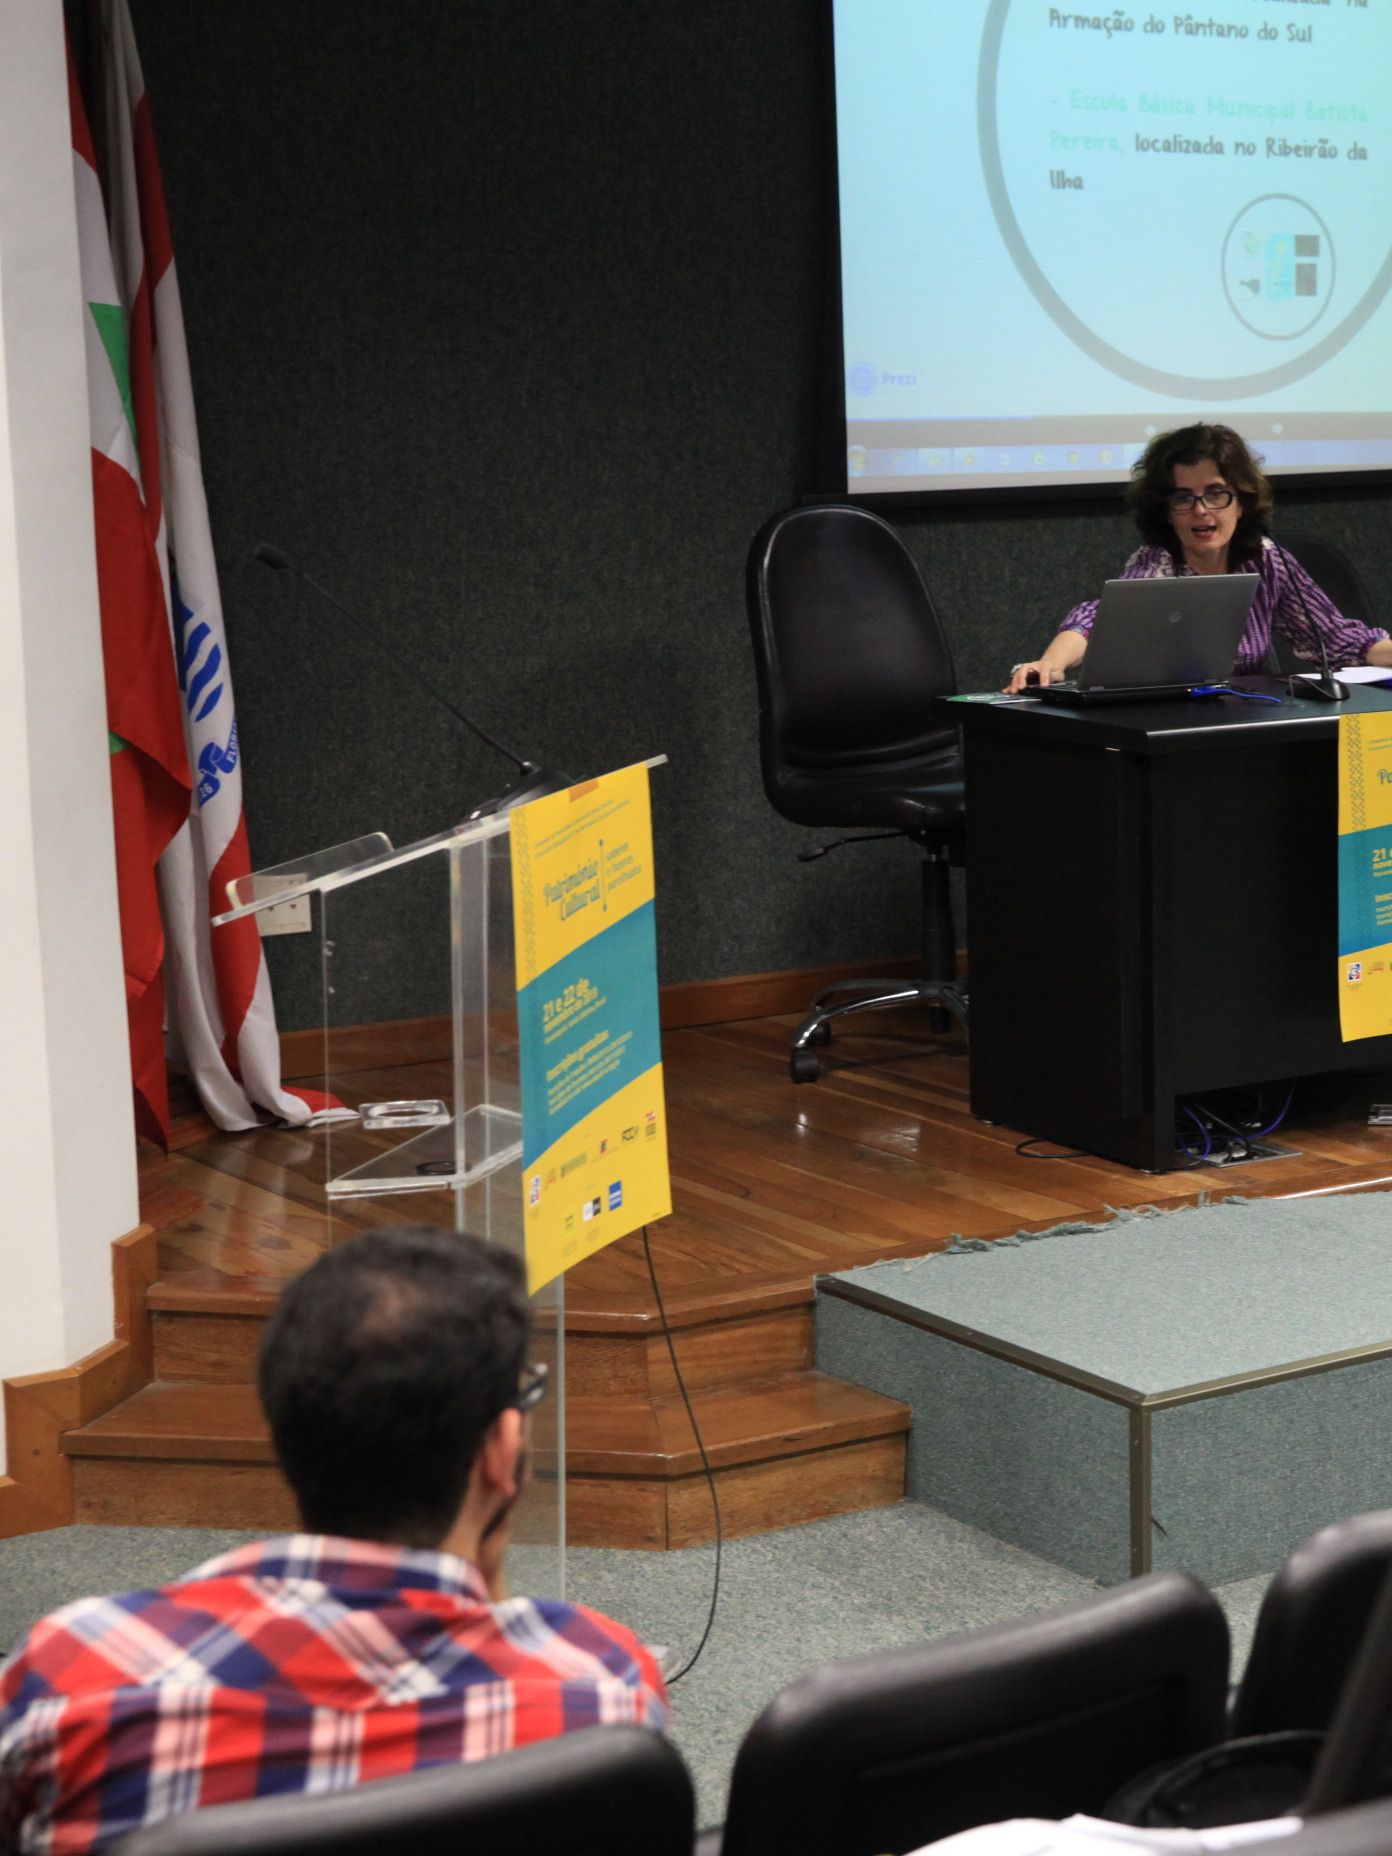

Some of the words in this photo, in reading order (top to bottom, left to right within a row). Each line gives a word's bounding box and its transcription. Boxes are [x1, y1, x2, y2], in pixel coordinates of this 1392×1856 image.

[1049, 8, 1134, 38] Armação
[1143, 14, 1165, 34] do
[1174, 15, 1249, 39] Pântano
[1257, 21, 1279, 41] do
[1287, 24, 1312, 43] Sul
[1069, 90, 1128, 112] Escola
[1138, 92, 1195, 115] Básica
[1207, 96, 1296, 124] Municipal
[1305, 101, 1369, 123] Batista
[1134, 133, 1225, 155] localizada
[1234, 140, 1257, 156] no
[1265, 137, 1338, 160] Ribeirão
[1347, 141, 1368, 161] da
[1049, 170, 1084, 190] Ilha
[881, 371, 917, 387] Prezi
[1372, 848, 1386, 862] 21
[559, 879, 600, 921] Cultural
[543, 1002, 554, 1023] 21
[563, 986, 575, 1003] 22
